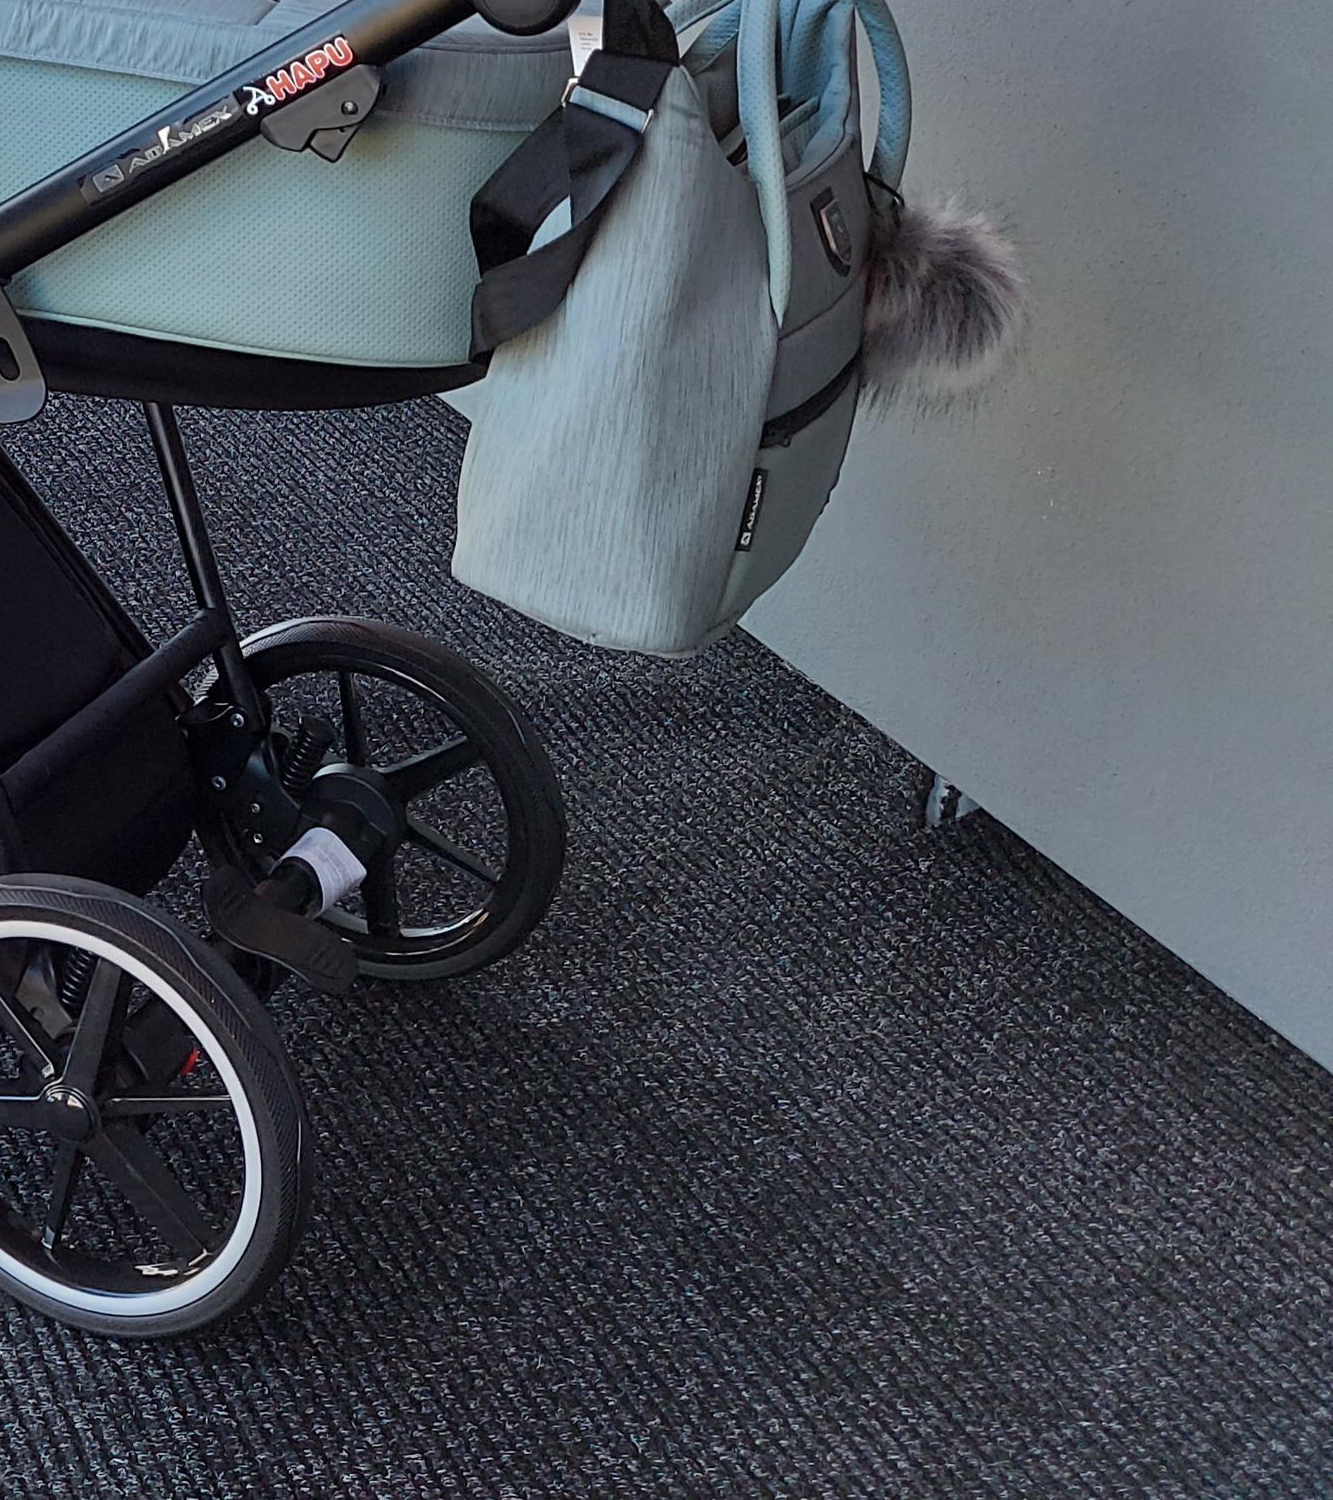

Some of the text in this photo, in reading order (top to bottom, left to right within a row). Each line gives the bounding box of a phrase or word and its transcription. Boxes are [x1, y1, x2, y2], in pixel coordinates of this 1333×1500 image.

[266, 37, 353, 100] HAPU
[129, 105, 233, 174] ADAMEX
[746, 474, 762, 530] ADAMEX
